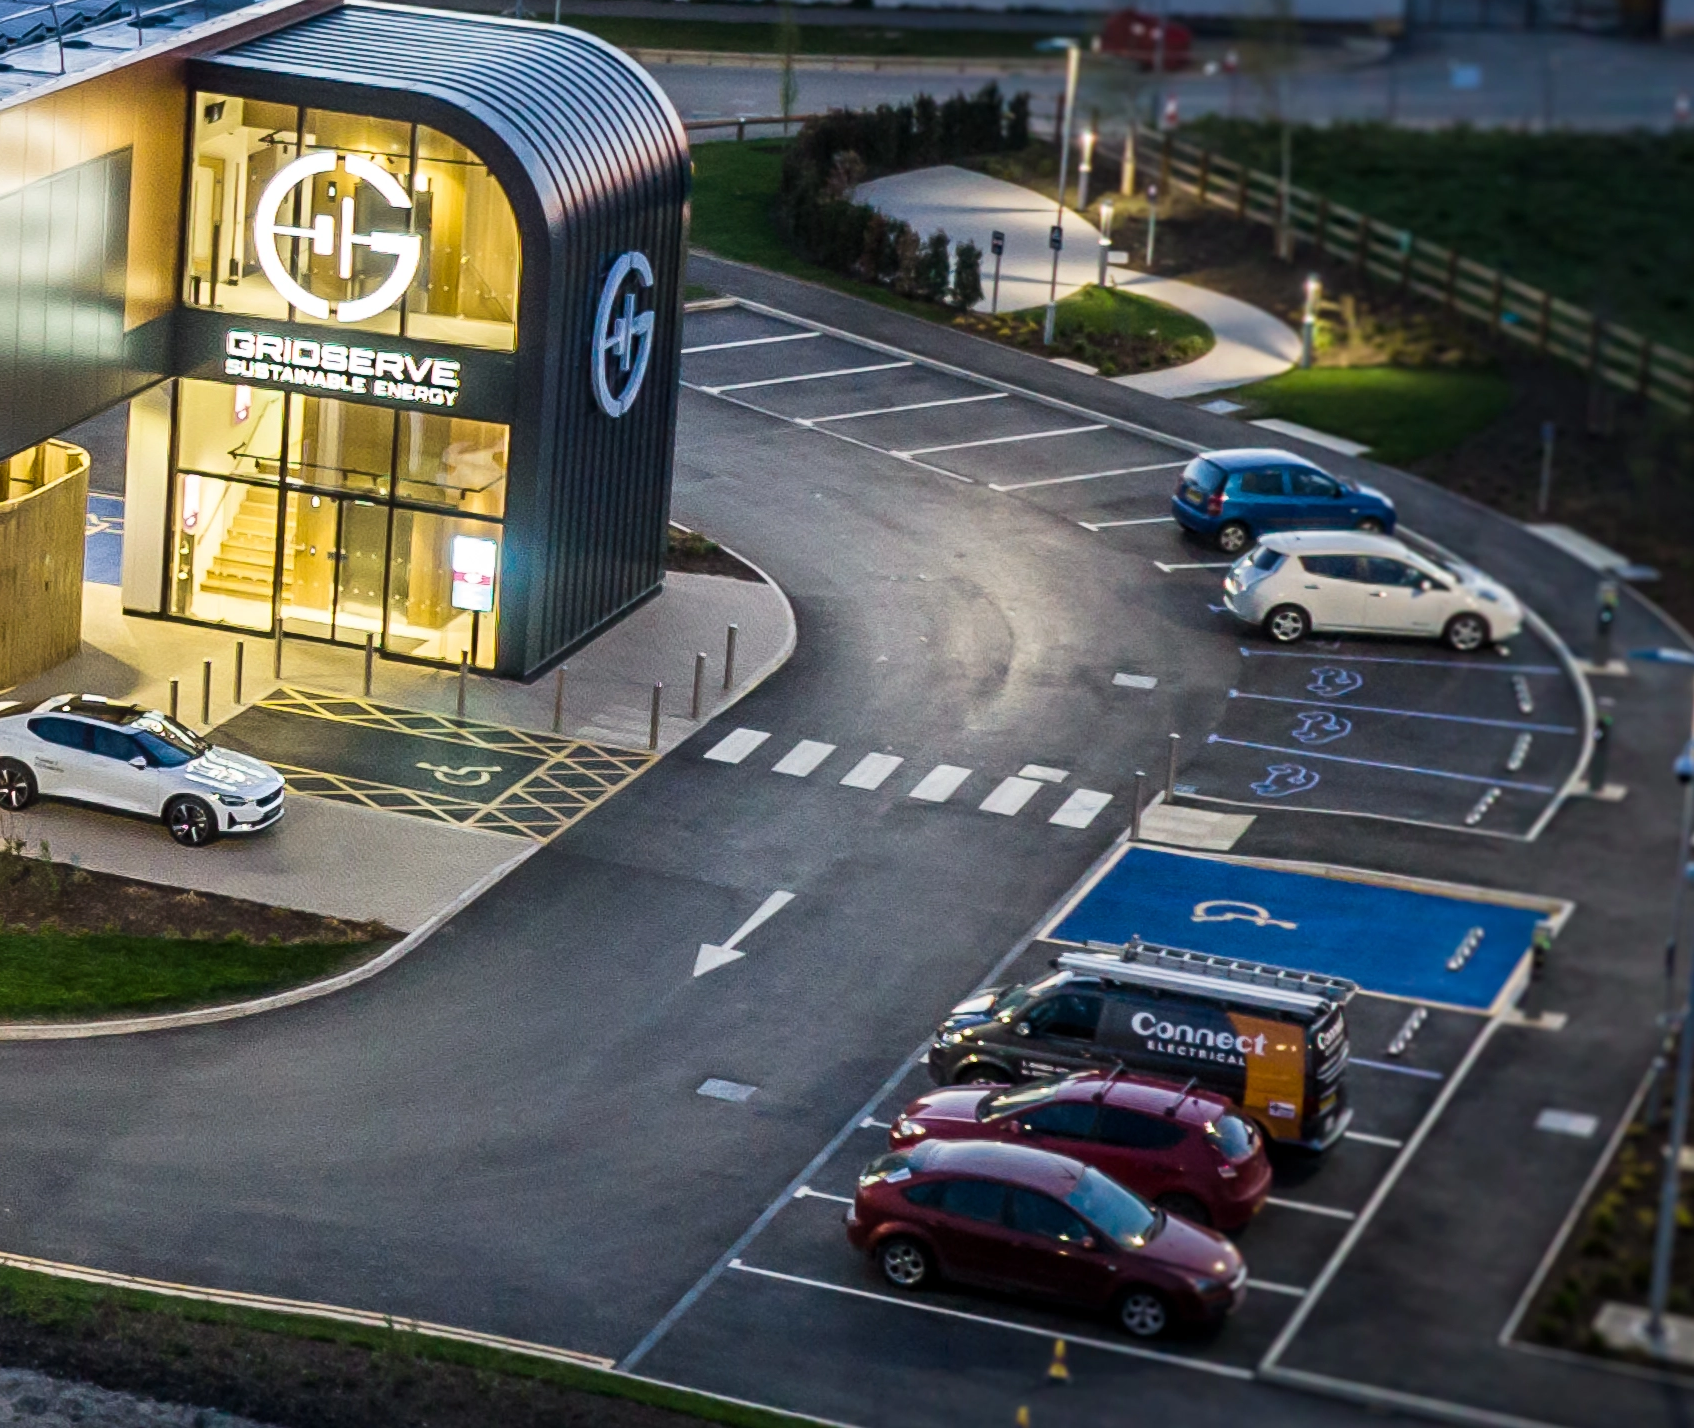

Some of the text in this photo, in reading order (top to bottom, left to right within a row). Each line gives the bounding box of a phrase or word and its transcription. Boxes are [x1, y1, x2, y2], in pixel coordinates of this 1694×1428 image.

[224, 357, 459, 408] SUSTAINABLE ENERGY
[225, 328, 461, 389] GRIDSERVE
[1131, 1012, 1268, 1057] Connect
[1146, 1039, 1247, 1067] ELECTRICAL
